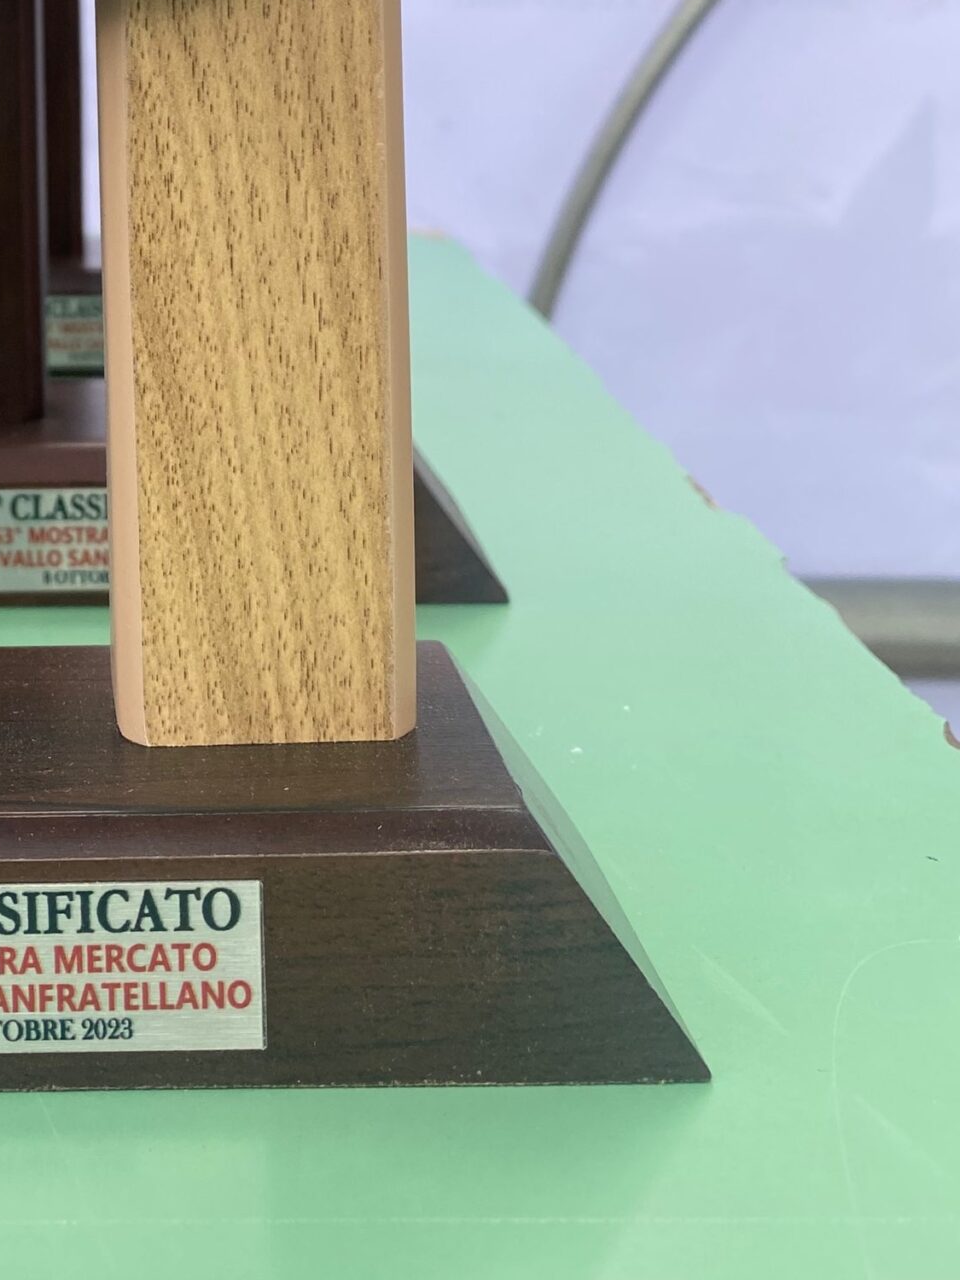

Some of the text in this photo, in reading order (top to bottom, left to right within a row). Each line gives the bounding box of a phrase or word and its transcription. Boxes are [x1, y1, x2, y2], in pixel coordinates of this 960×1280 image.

[10, 493, 108, 521] CLASSI
[67, 548, 109, 567] SAN
[53, 942, 218, 974] MERCATO
[81, 1017, 135, 1041] 2023
